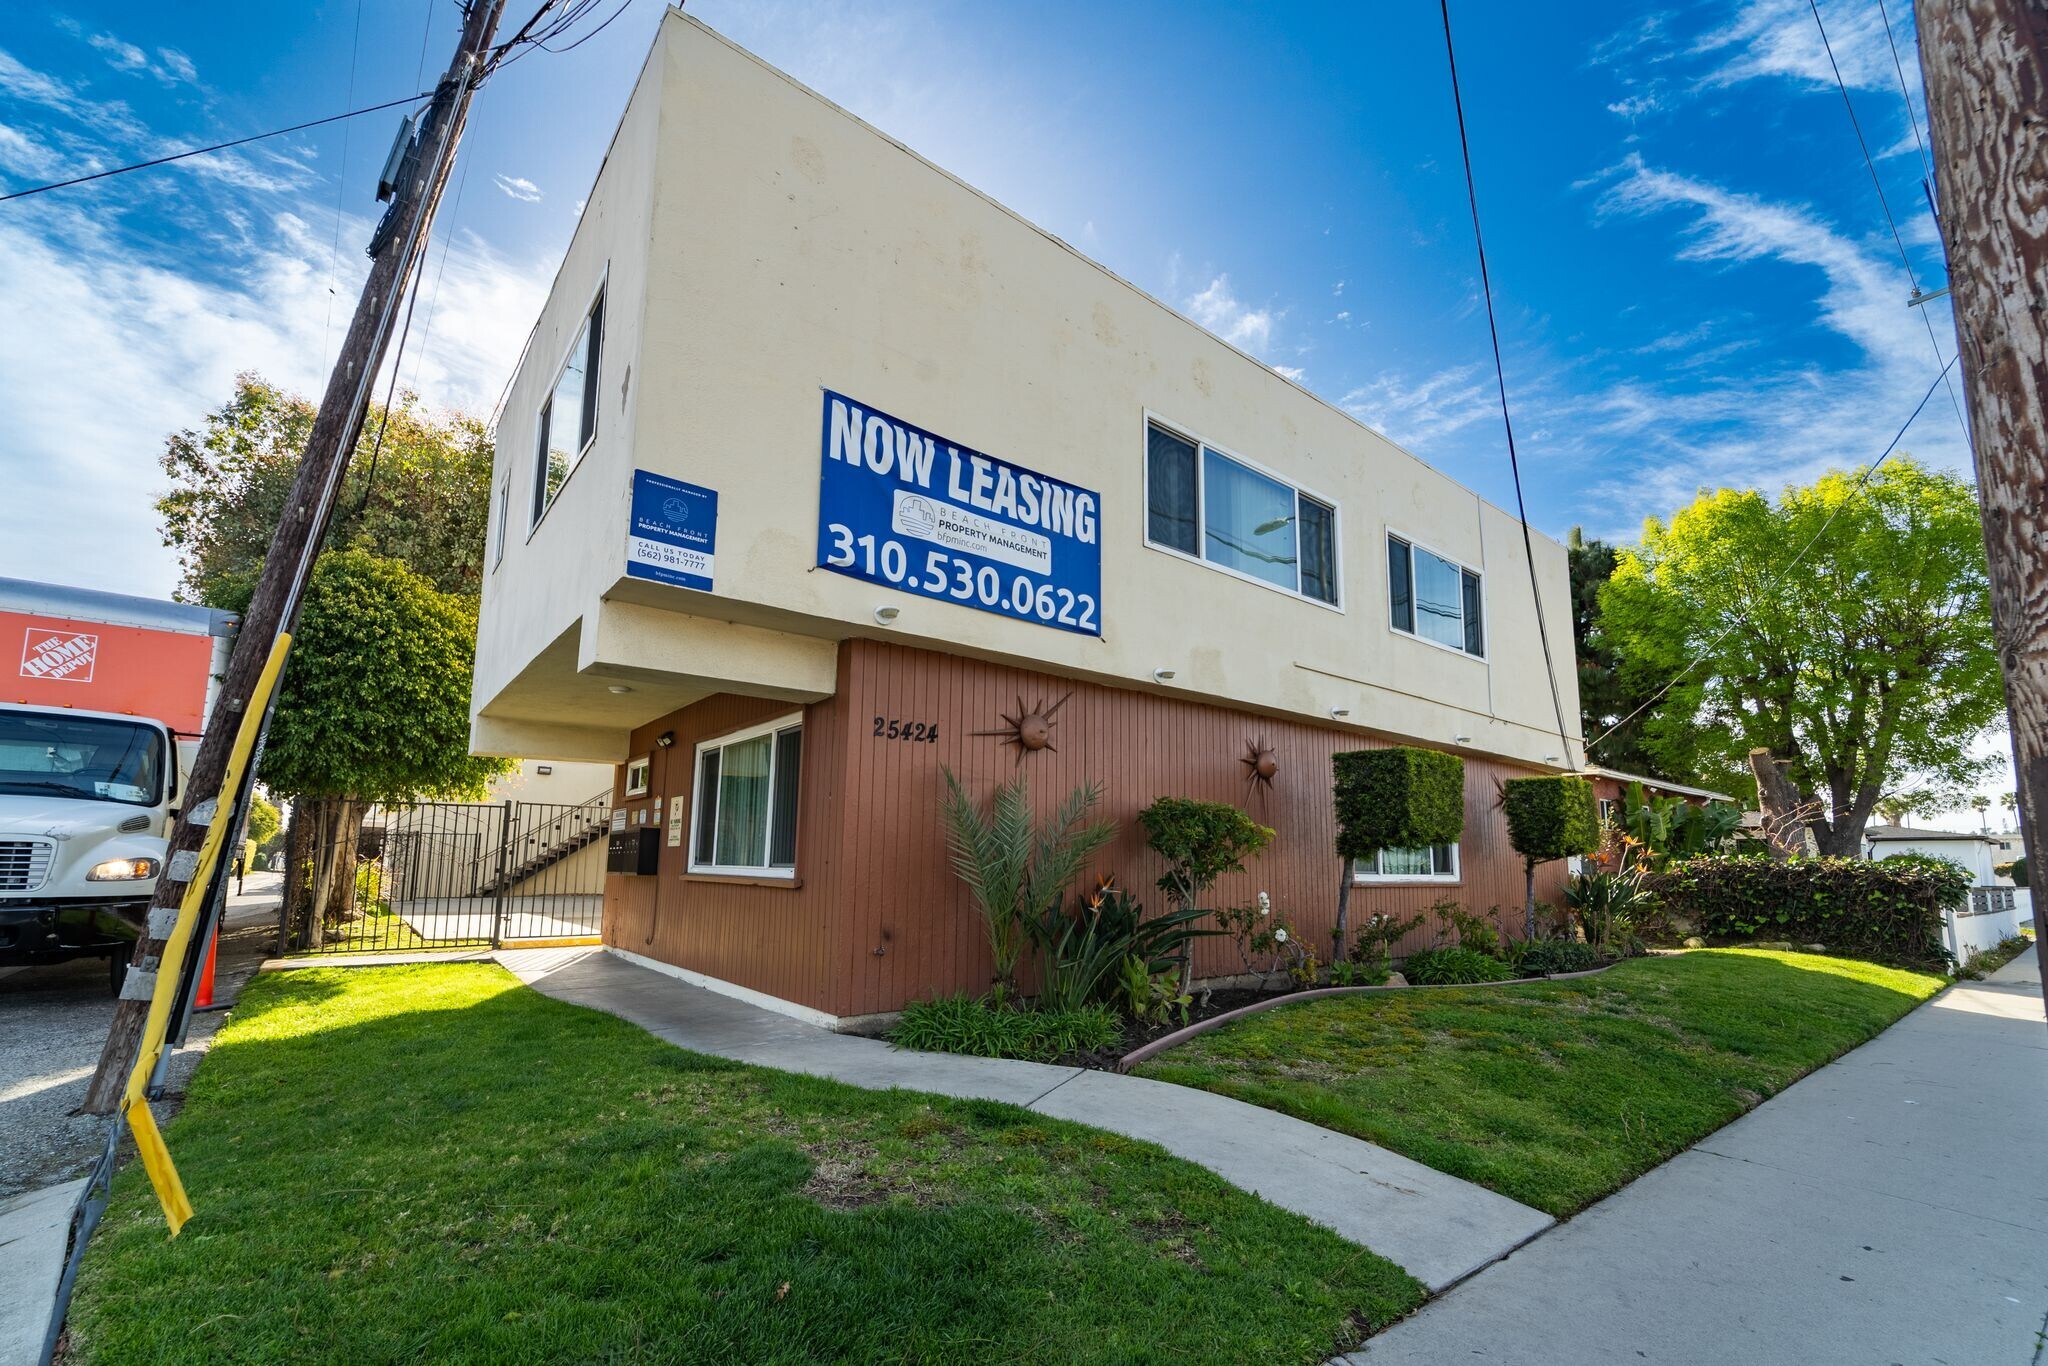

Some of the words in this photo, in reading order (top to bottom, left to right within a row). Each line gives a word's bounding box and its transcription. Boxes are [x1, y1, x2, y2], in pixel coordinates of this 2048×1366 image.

[829, 399, 935, 488] NOW
[948, 447, 1096, 544] LEASING
[638, 523, 668, 534] PROPERTY
[669, 529, 708, 544] MANAGEMENT
[639, 517, 671, 528] BEACH
[677, 527, 708, 538] FRONT
[938, 519, 987, 541] PROPERTY
[989, 535, 1048, 560] MANAGEMENT
[940, 507, 991, 530] BEACH
[1001, 528, 1047, 548] FRONT
[638, 541, 660, 552] CALL
[663, 546, 674, 554] US
[678, 551, 705, 561] TODAY
[937, 531, 988, 553] bfpminc.com
[637, 548, 662, 561] (562)
[664, 554, 705, 570] 981-7777
[827, 523, 1097, 631] 310.530.0622
[23, 634, 96, 676] HOME
[32, 636, 63, 654] THE
[49, 652, 94, 679] DEPOT
[873, 717, 938, 743] 25424
